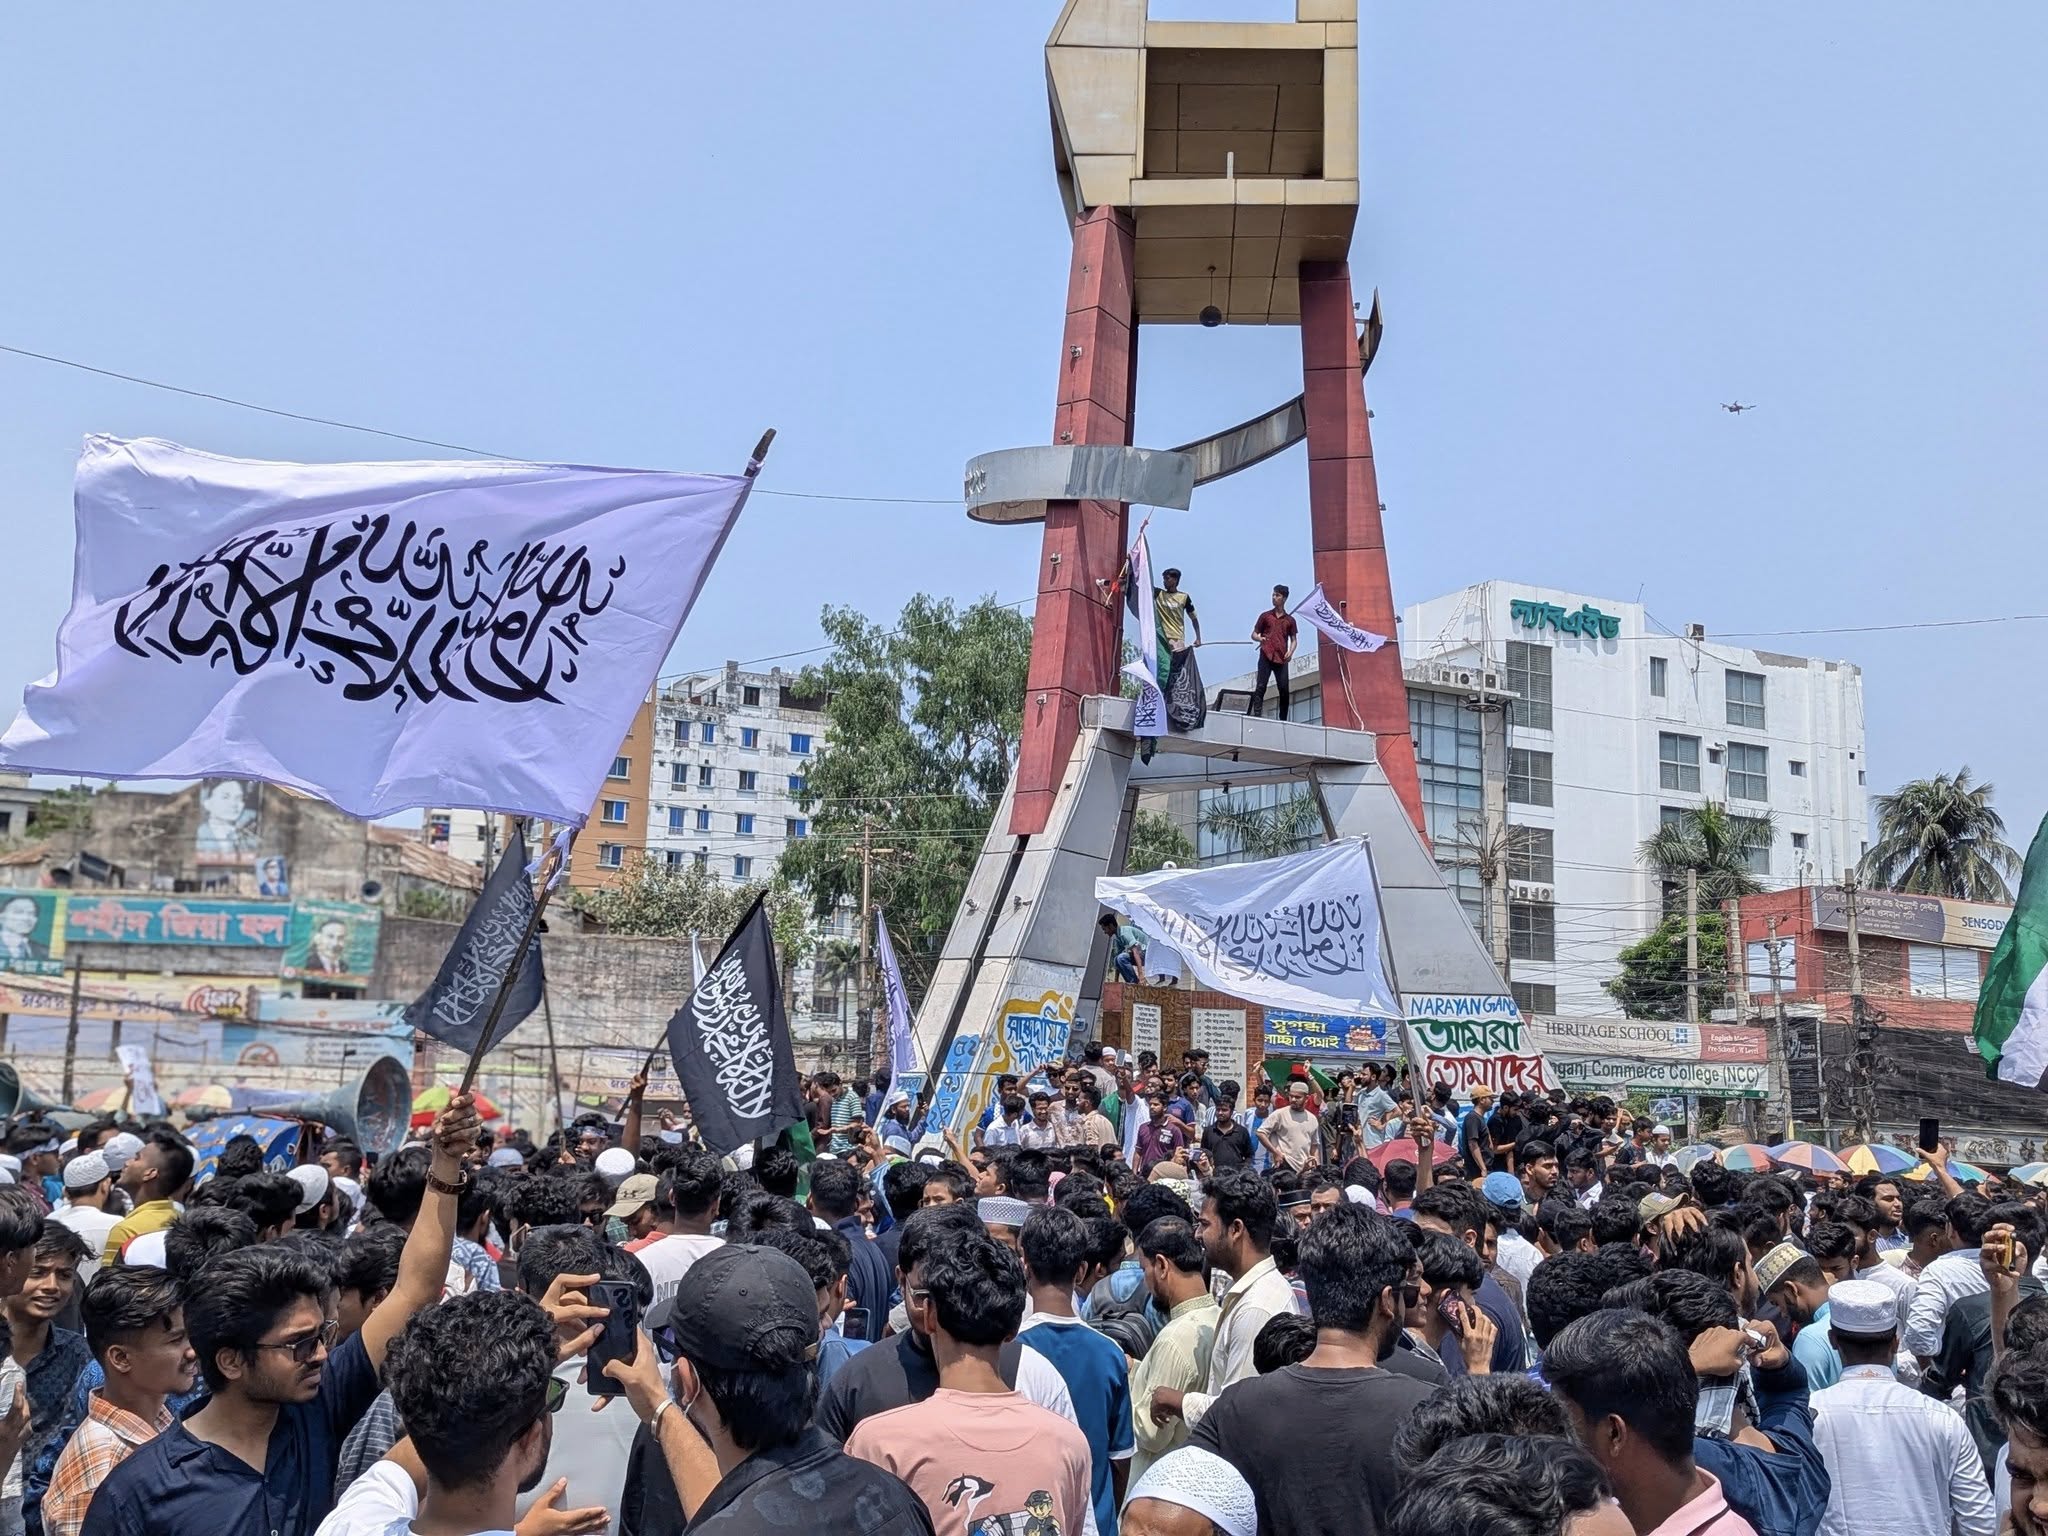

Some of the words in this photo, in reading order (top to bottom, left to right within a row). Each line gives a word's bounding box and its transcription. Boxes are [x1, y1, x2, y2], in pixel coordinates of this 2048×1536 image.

[1301, 1035, 1340, 1049] সেমাই
[1407, 1018, 1525, 1054] আমরা
[1546, 1022, 1616, 1039] HERITAGE
[1618, 1026, 1674, 1042] SCHOOL
[1592, 1060, 1664, 1079] Commerce
[1669, 1063, 1719, 1085] College
[1723, 1065, 1759, 1088] (NCC)
